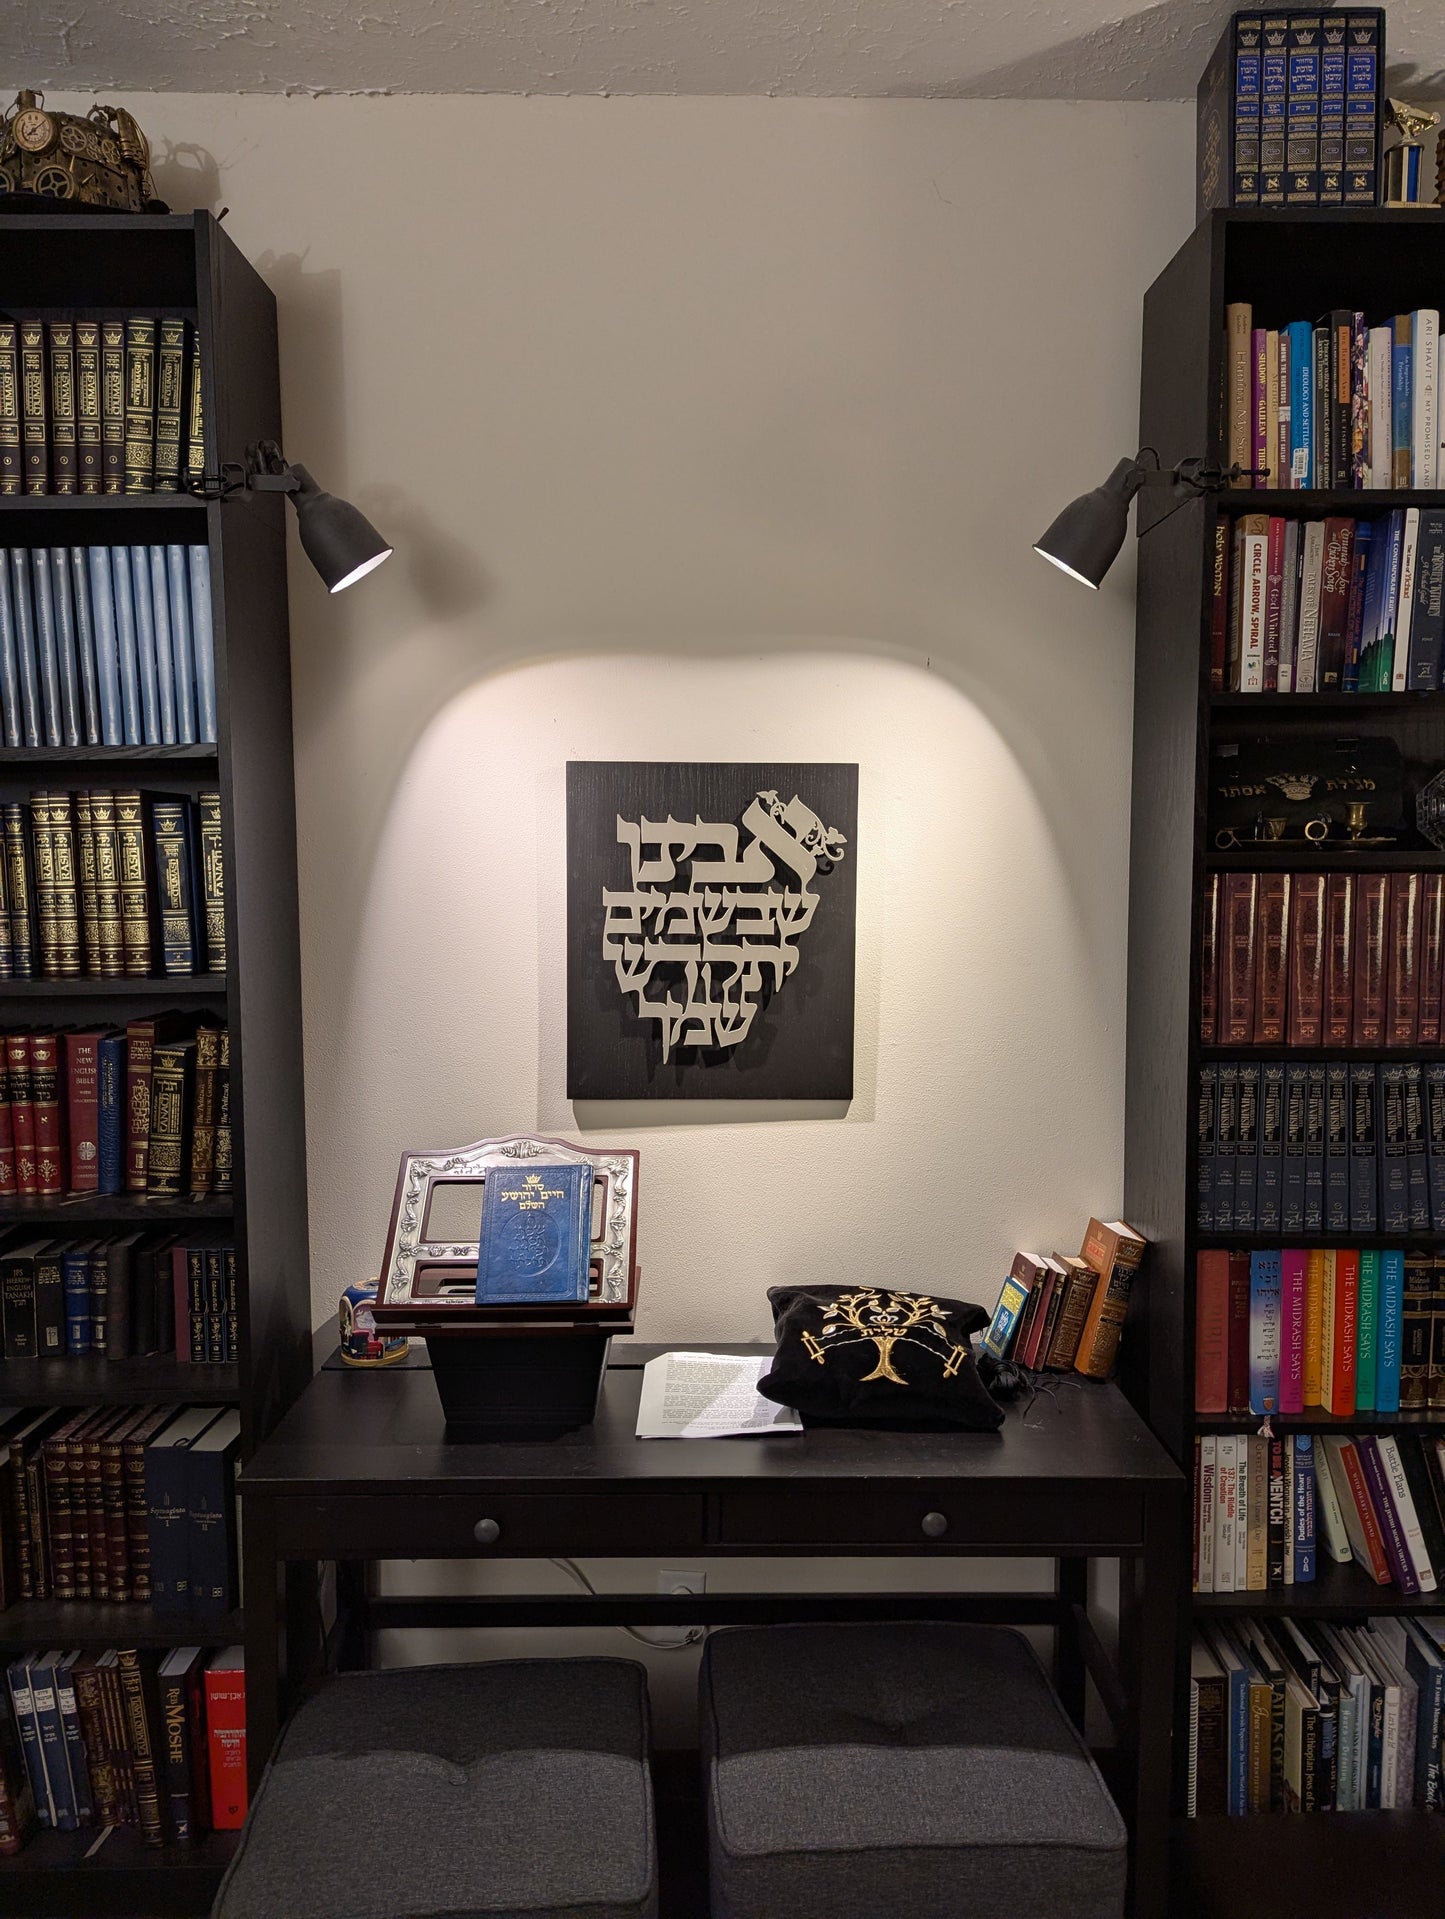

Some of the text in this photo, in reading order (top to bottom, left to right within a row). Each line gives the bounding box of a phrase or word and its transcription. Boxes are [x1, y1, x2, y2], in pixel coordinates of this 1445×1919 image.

[1425, 342, 1433, 380] SHAVIT
[1425, 400, 1431, 412] MY
[1306, 572, 1316, 594] TALES
[1326, 571, 1340, 593] Soup
[1335, 529, 1354, 596] Emunah Love
[1390, 543, 1399, 595] CONTEMPORARY
[1250, 543, 1262, 649] CIRCLE, ARROW, SPIRAL
[1268, 589, 1279, 653] God Winked
[1300, 609, 1318, 662] NEHAMA
[501, 1191, 564, 1202] חיים יהושע
[519, 1200, 545, 1210] השלם
[1256, 1288, 1280, 1297] אליהו
[1307, 1257, 1318, 1362] THE MIDRASH SAYS
[1343, 1265, 1355, 1372] THE MIDRASH SAYS
[1360, 1253, 1373, 1359] THE MIDRASH SAYS
[1384, 1258, 1398, 1367] THE MIDRASH SAYS
[860, 1326, 907, 1337] טלית
[1291, 1270, 1303, 1380] THE MIDRASH SAYS
[1203, 1464, 1214, 1503] Wisdom
[1239, 1461, 1247, 1474] The
[1270, 1441, 1283, 1525] TO MENTCH
[1352, 1472, 1361, 1488] WITH
[1357, 1491, 1367, 1511] HEART
[1385, 1447, 1406, 1499] Battle Plans
[1239, 1499, 1246, 1507] of
[1298, 1508, 1305, 1516] of
[1384, 1508, 1395, 1529] JEWISH
[1391, 1529, 1400, 1548] MORAL
[1397, 1549, 1408, 1572] VIRTUES
[165, 1704, 185, 1764] MOSHE
[1272, 1692, 1284, 1744] ATLAS
[1304, 1715, 1316, 1800] The Ethiopian Jews of
[1425, 1763, 1439, 1803] The Book
